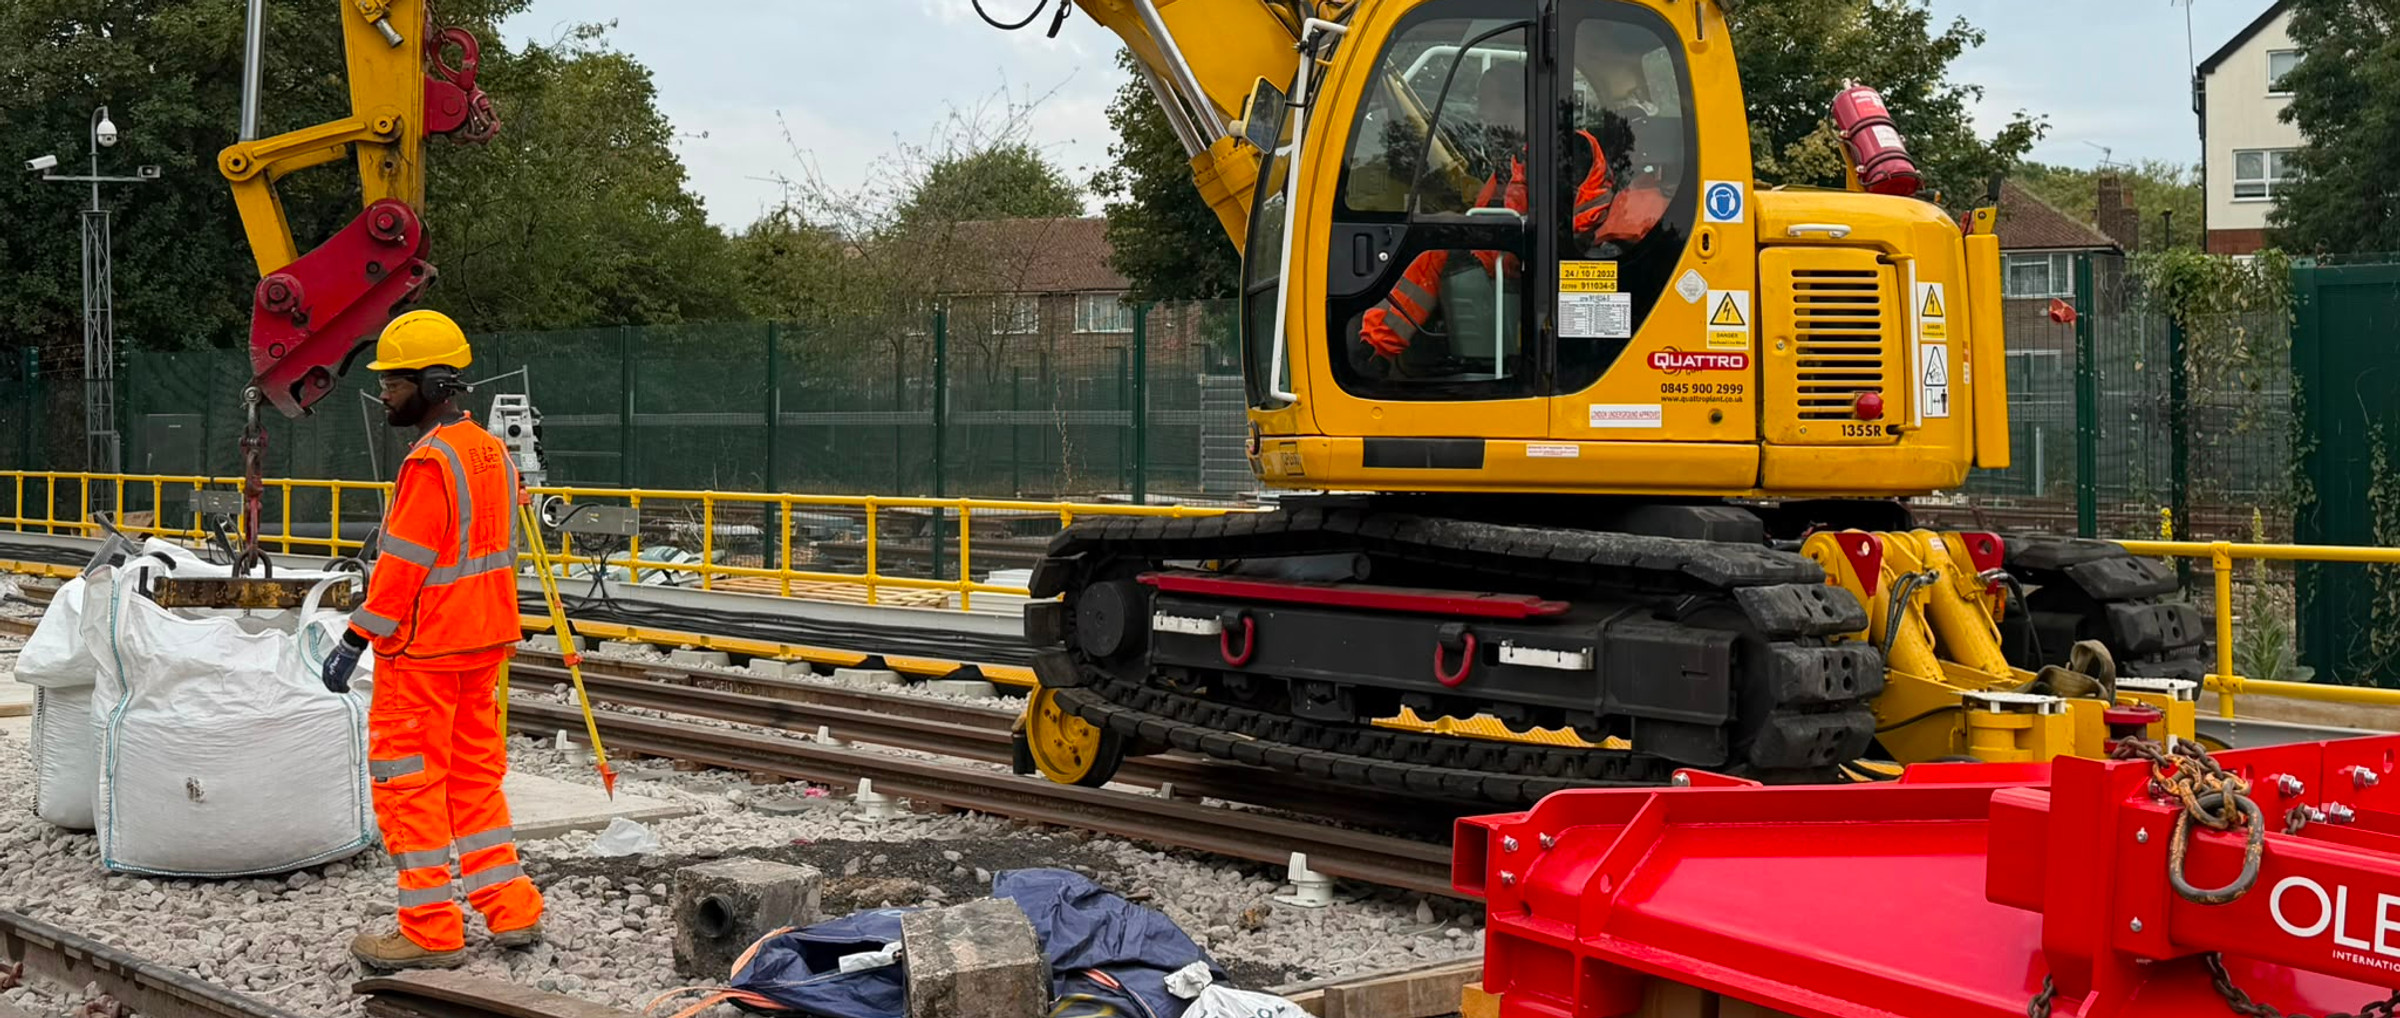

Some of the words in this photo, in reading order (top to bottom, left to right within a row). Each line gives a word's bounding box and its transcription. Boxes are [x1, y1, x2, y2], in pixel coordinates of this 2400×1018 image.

[1654, 353, 1743, 368] QUATTRO
[1661, 383, 1689, 393] 0845
[1692, 383, 1713, 393] 900
[1716, 384, 1743, 394] 2999
[1661, 395, 1743, 403] www.quattroplant.co.uk
[1842, 424, 1882, 437] 135SR
